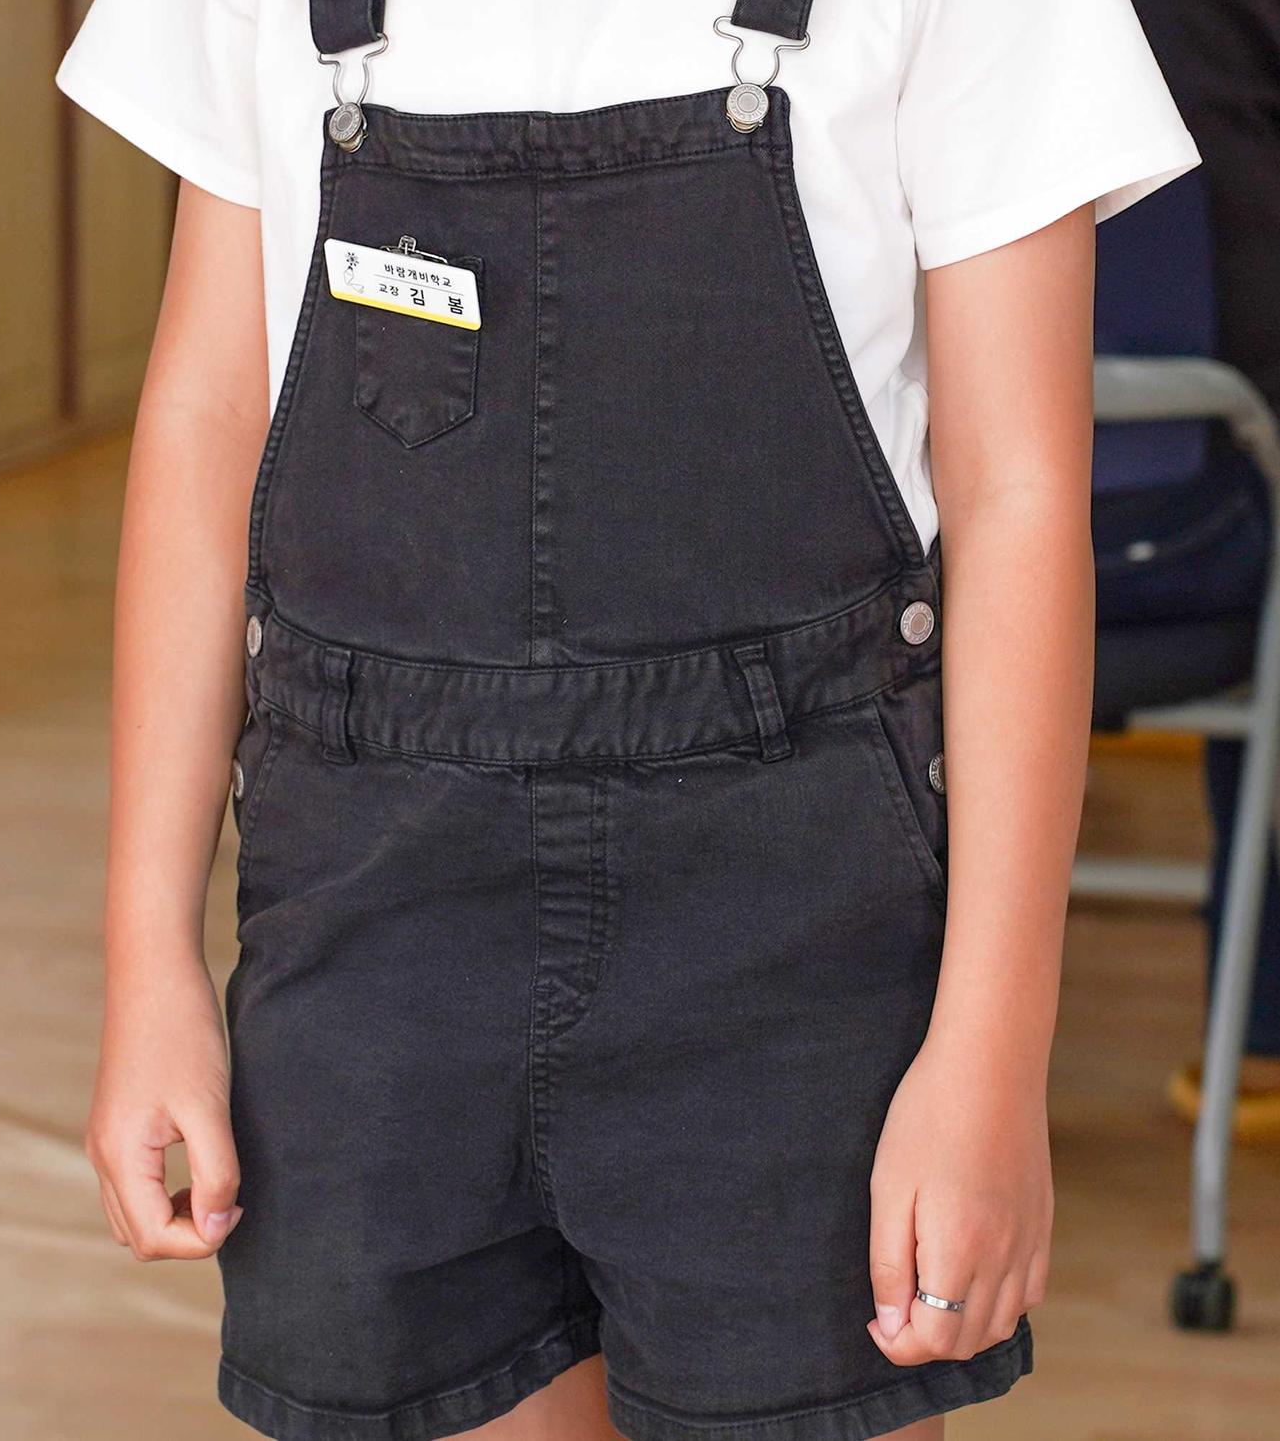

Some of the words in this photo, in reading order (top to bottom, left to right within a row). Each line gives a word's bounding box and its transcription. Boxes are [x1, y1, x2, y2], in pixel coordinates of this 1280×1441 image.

[384, 264, 452, 287] 바람개비학교
[378, 283, 399, 296] 교장
[409, 287, 425, 306] 김
[448, 296, 464, 315] 봄
